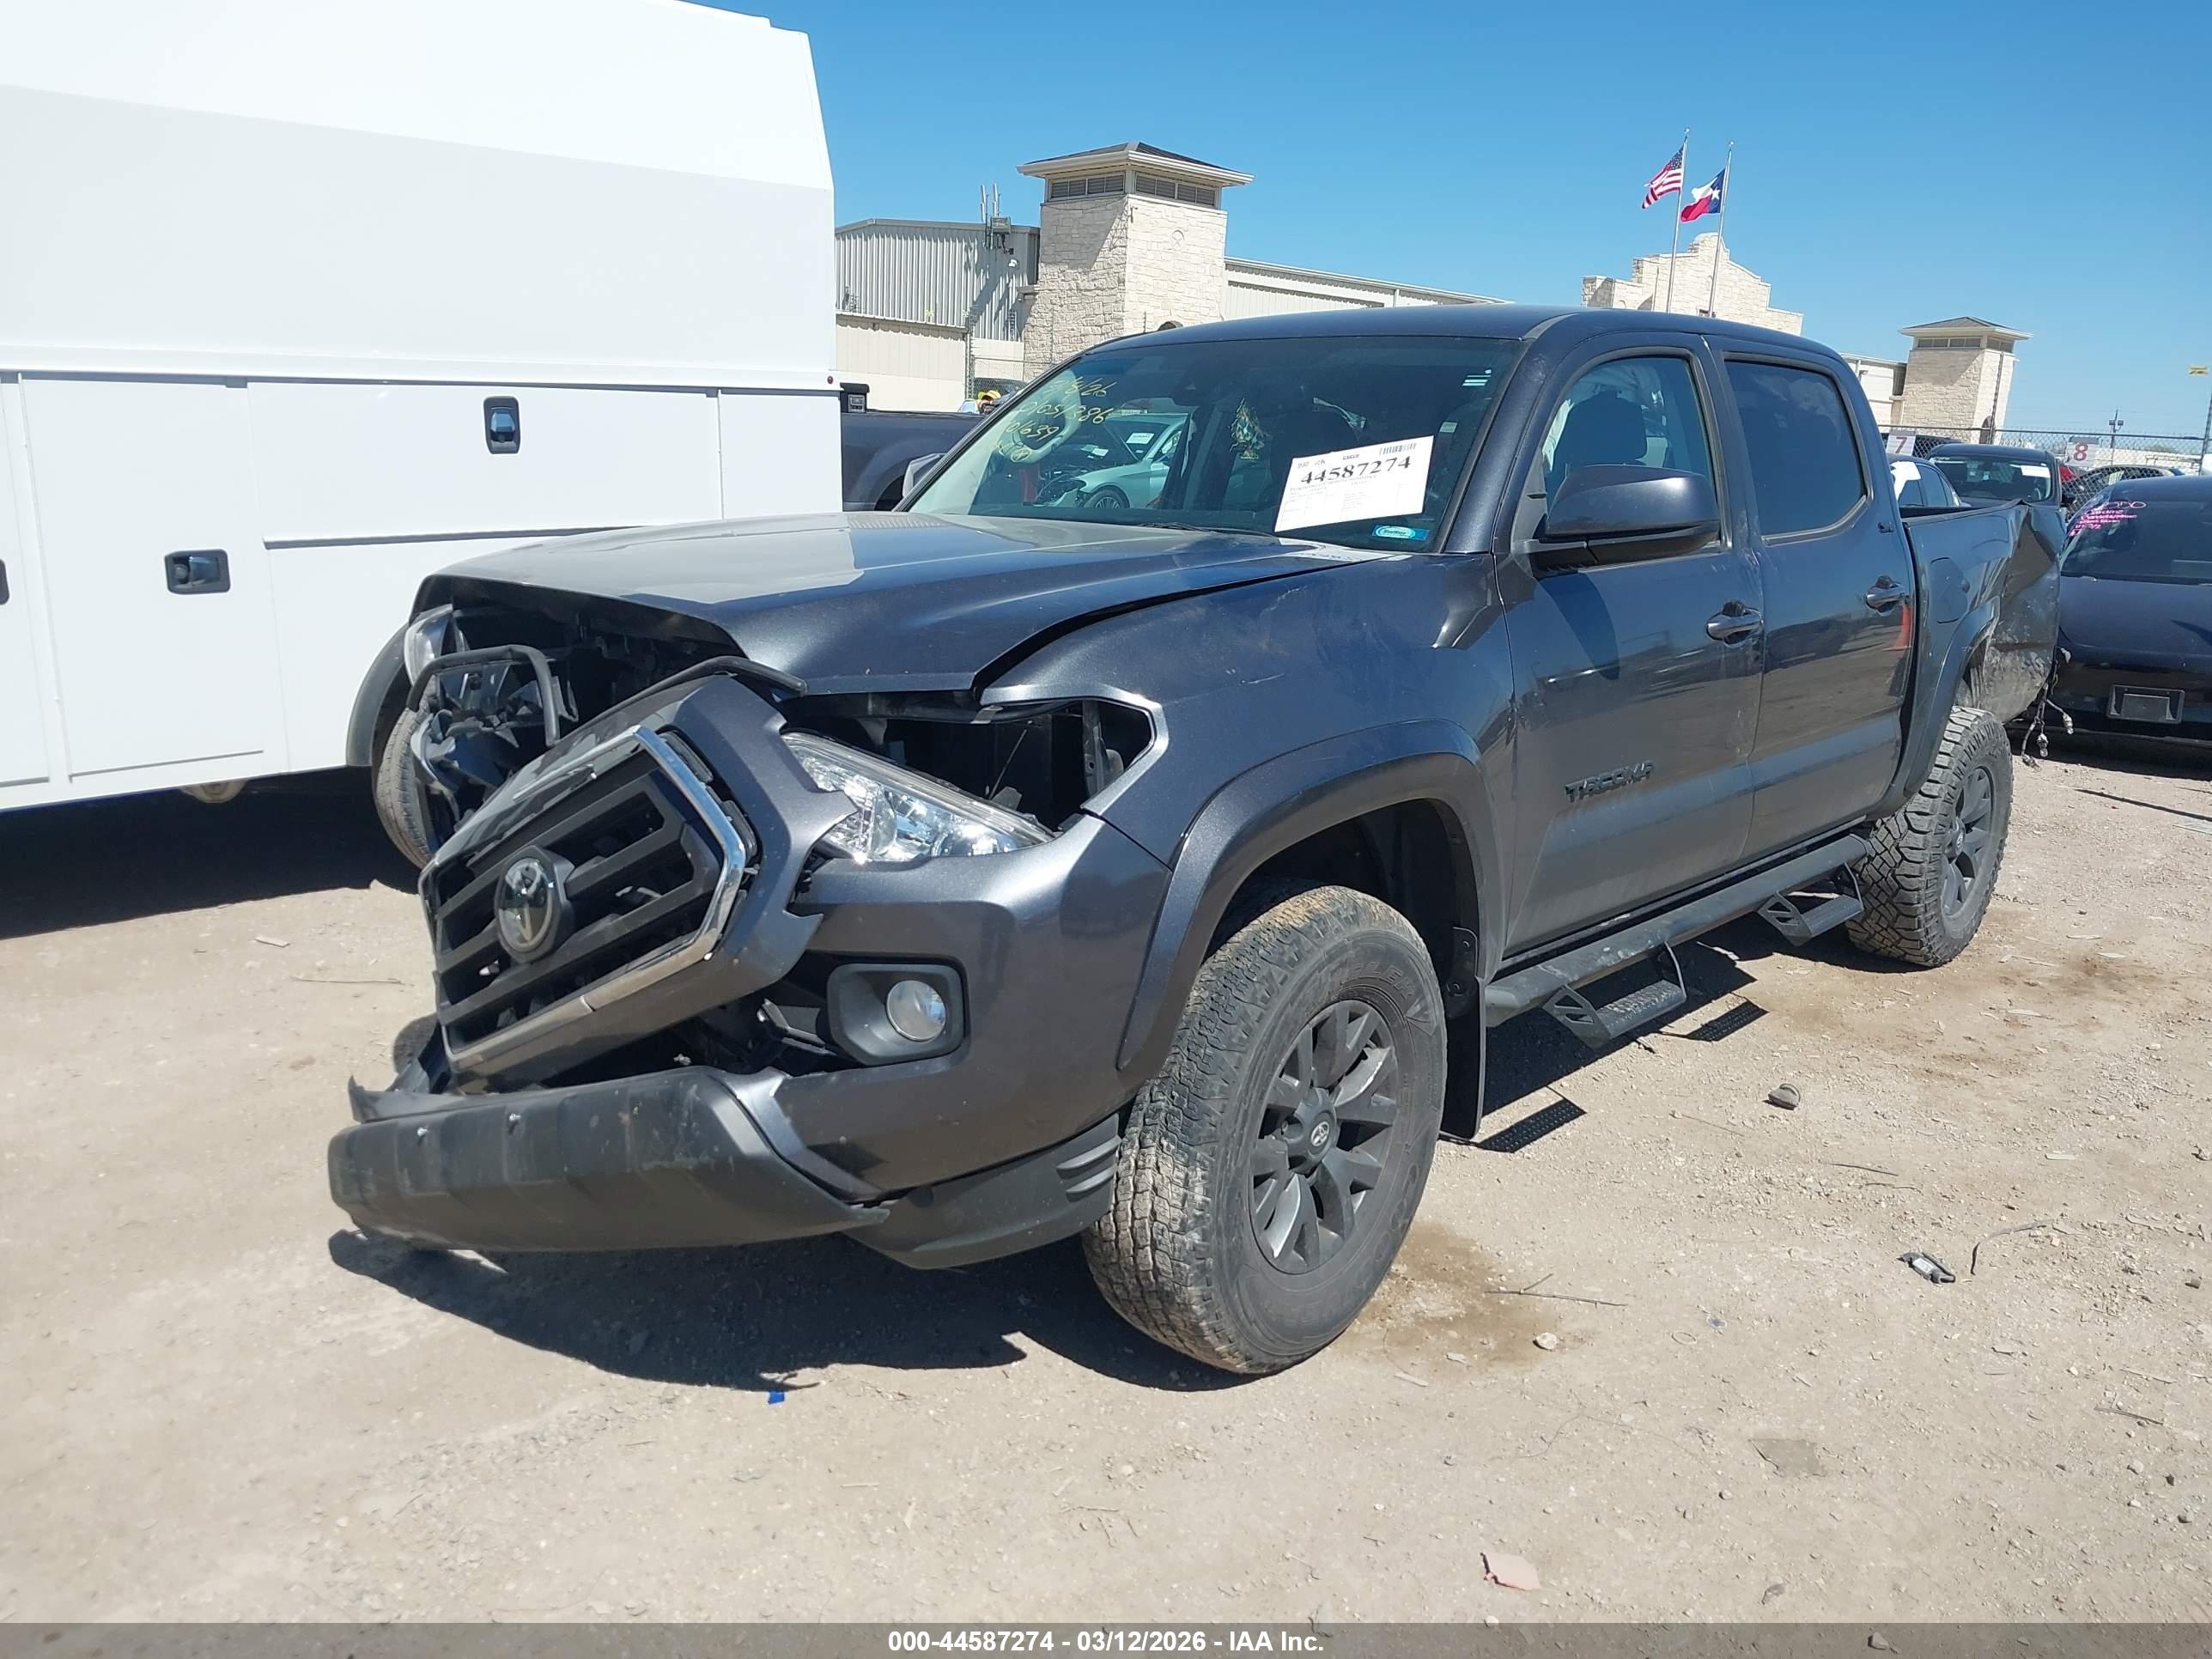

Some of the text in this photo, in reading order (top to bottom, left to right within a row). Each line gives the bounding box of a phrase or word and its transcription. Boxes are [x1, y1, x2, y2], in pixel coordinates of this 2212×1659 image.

[1895, 436, 1907, 454] 7
[2073, 442, 2088, 461] 8
[1301, 456, 1411, 484] 44587274
